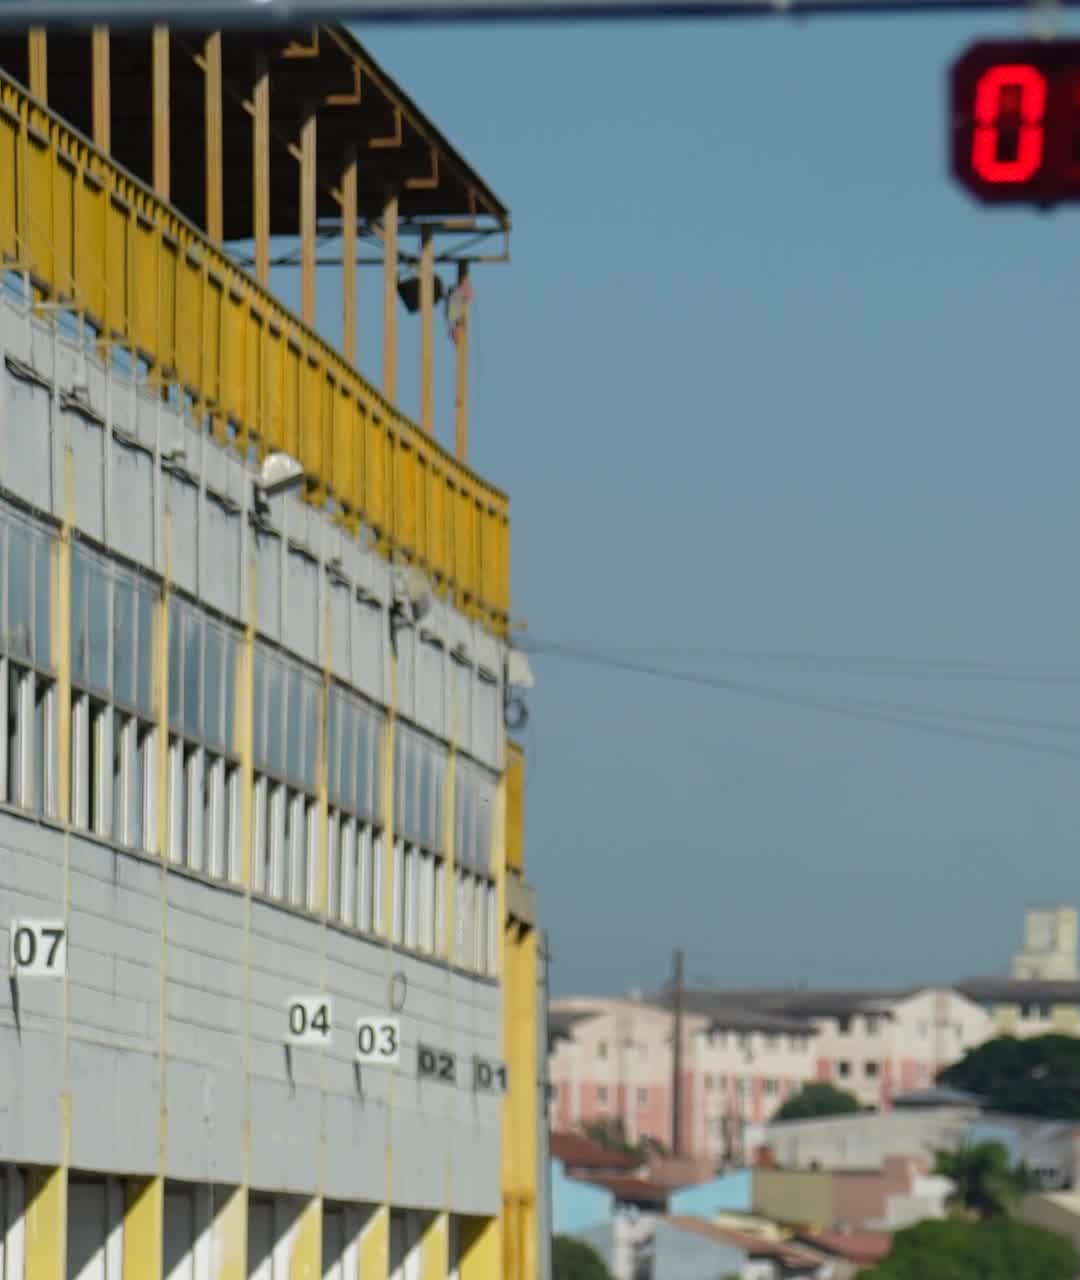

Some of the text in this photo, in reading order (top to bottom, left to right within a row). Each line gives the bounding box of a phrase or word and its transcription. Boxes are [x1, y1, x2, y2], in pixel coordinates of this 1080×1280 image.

[14, 927, 65, 967] 07
[289, 1003, 329, 1036] 04
[358, 1024, 397, 1056] 03
[418, 1048, 456, 1082] 02
[474, 1061, 508, 1089] 01
